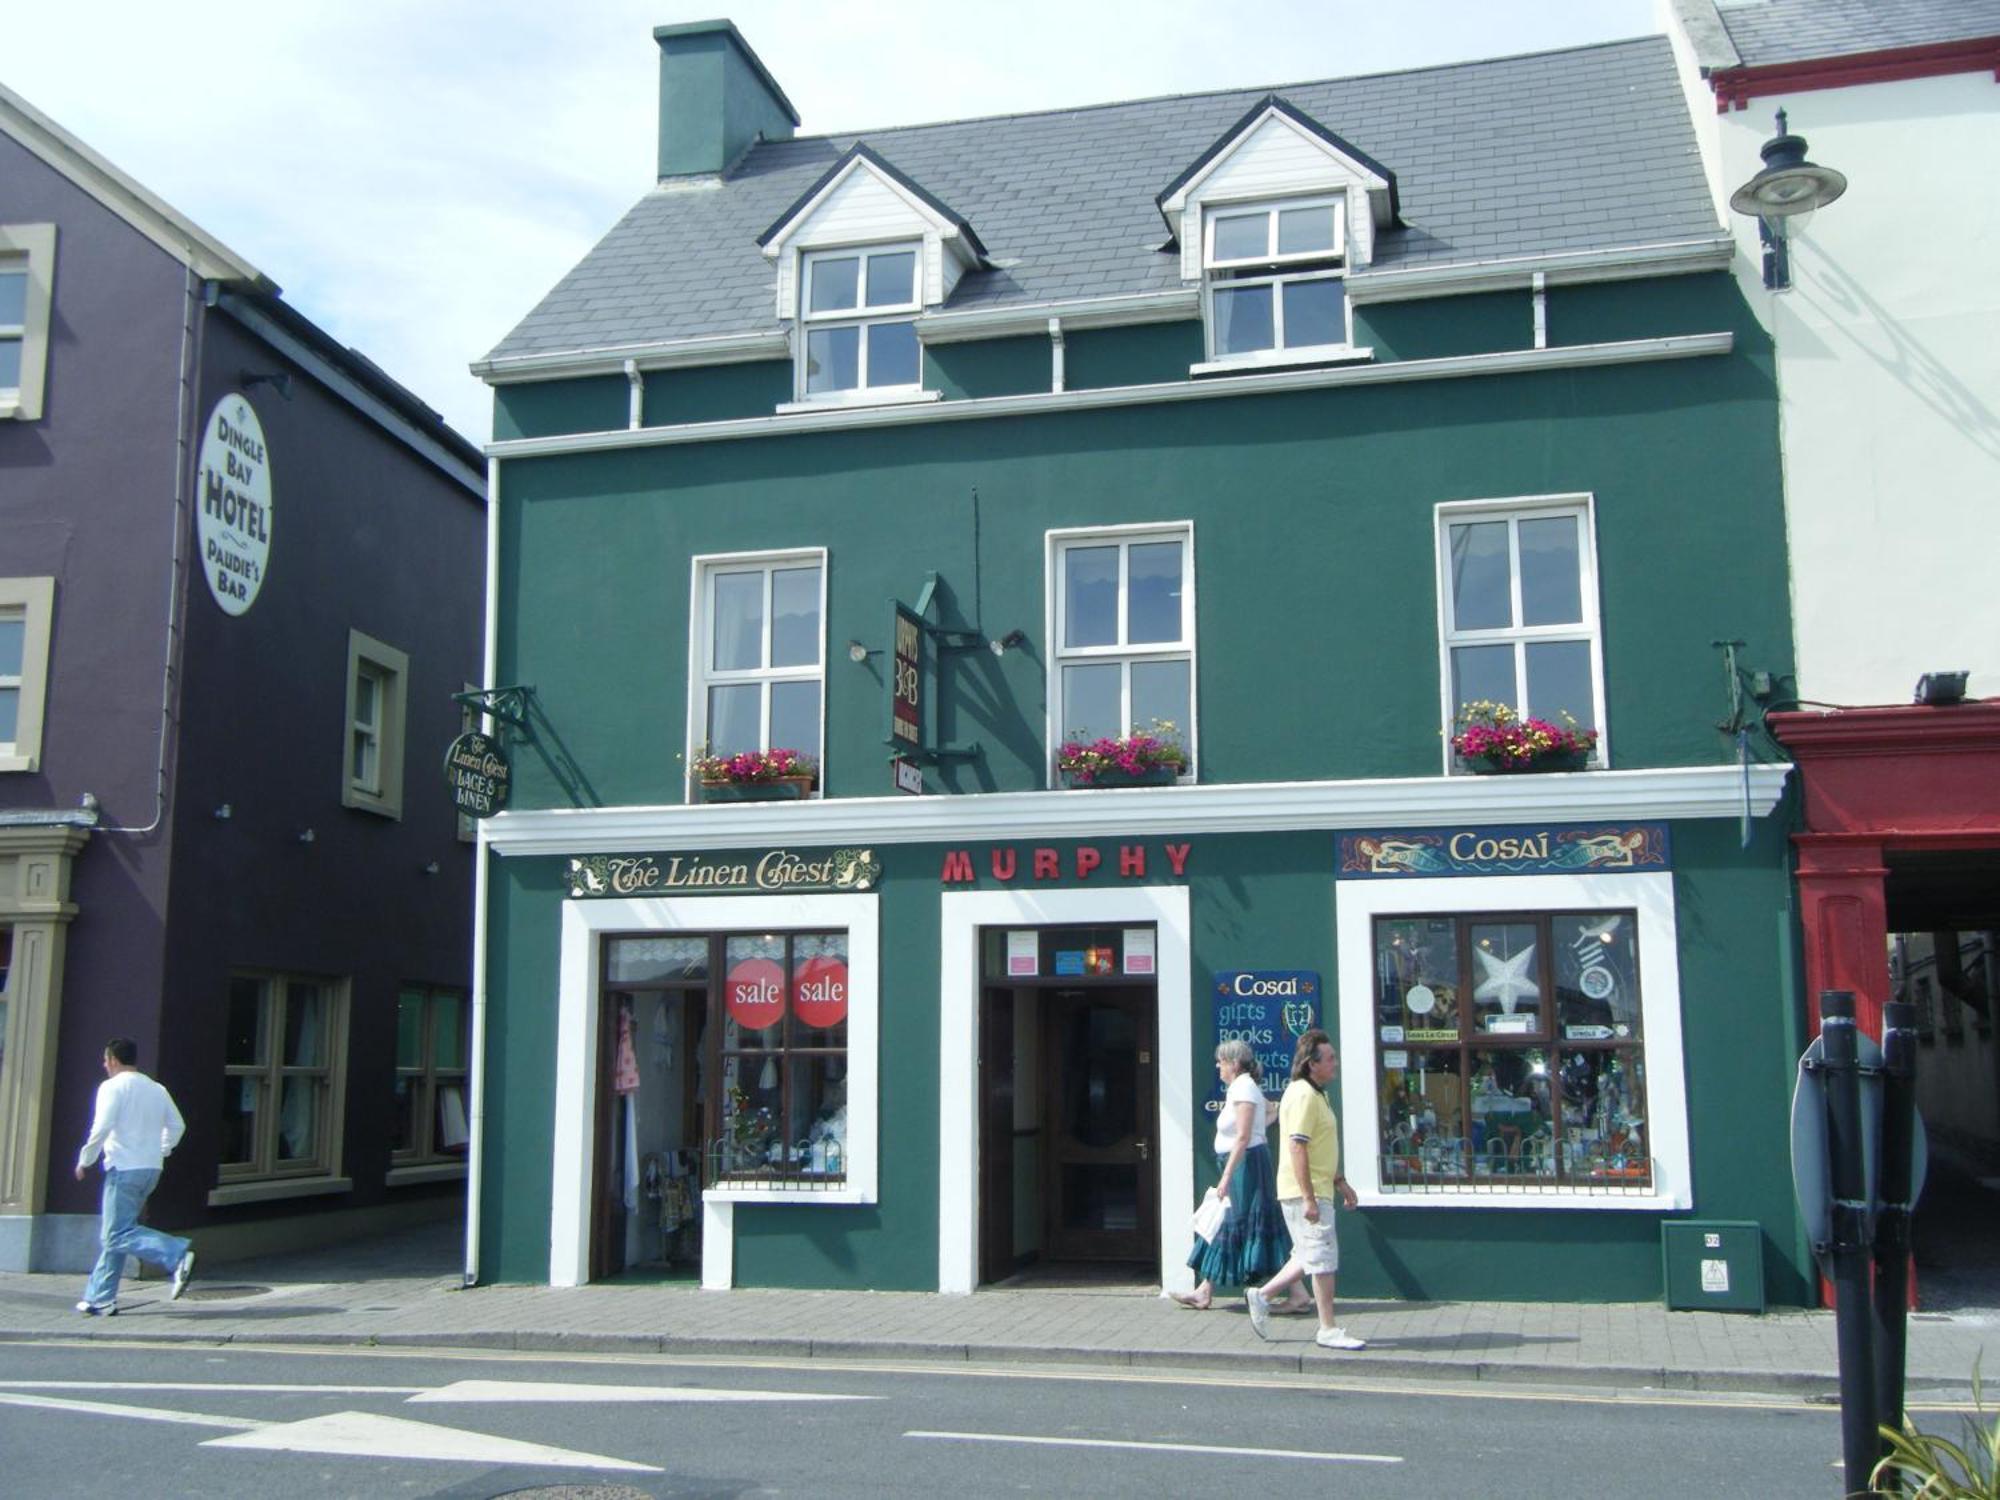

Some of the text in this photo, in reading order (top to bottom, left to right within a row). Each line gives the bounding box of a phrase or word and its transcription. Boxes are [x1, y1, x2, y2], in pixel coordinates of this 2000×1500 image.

[217, 415, 263, 465] DINGLE
[227, 450, 253, 486] BAY
[205, 467, 268, 544] HOTEL
[207, 537, 260, 583] PAUDIE'S
[217, 570, 247, 602] BAR
[453, 744, 508, 779] Linen Chest
[607, 850, 835, 894] The Linen Chest
[941, 843, 1191, 882] MURPHY
[735, 977, 780, 1004] sale
[800, 975, 844, 1002] sale
[1234, 973, 1298, 997] Cosaí
[1218, 1002, 1267, 1027] gifts
